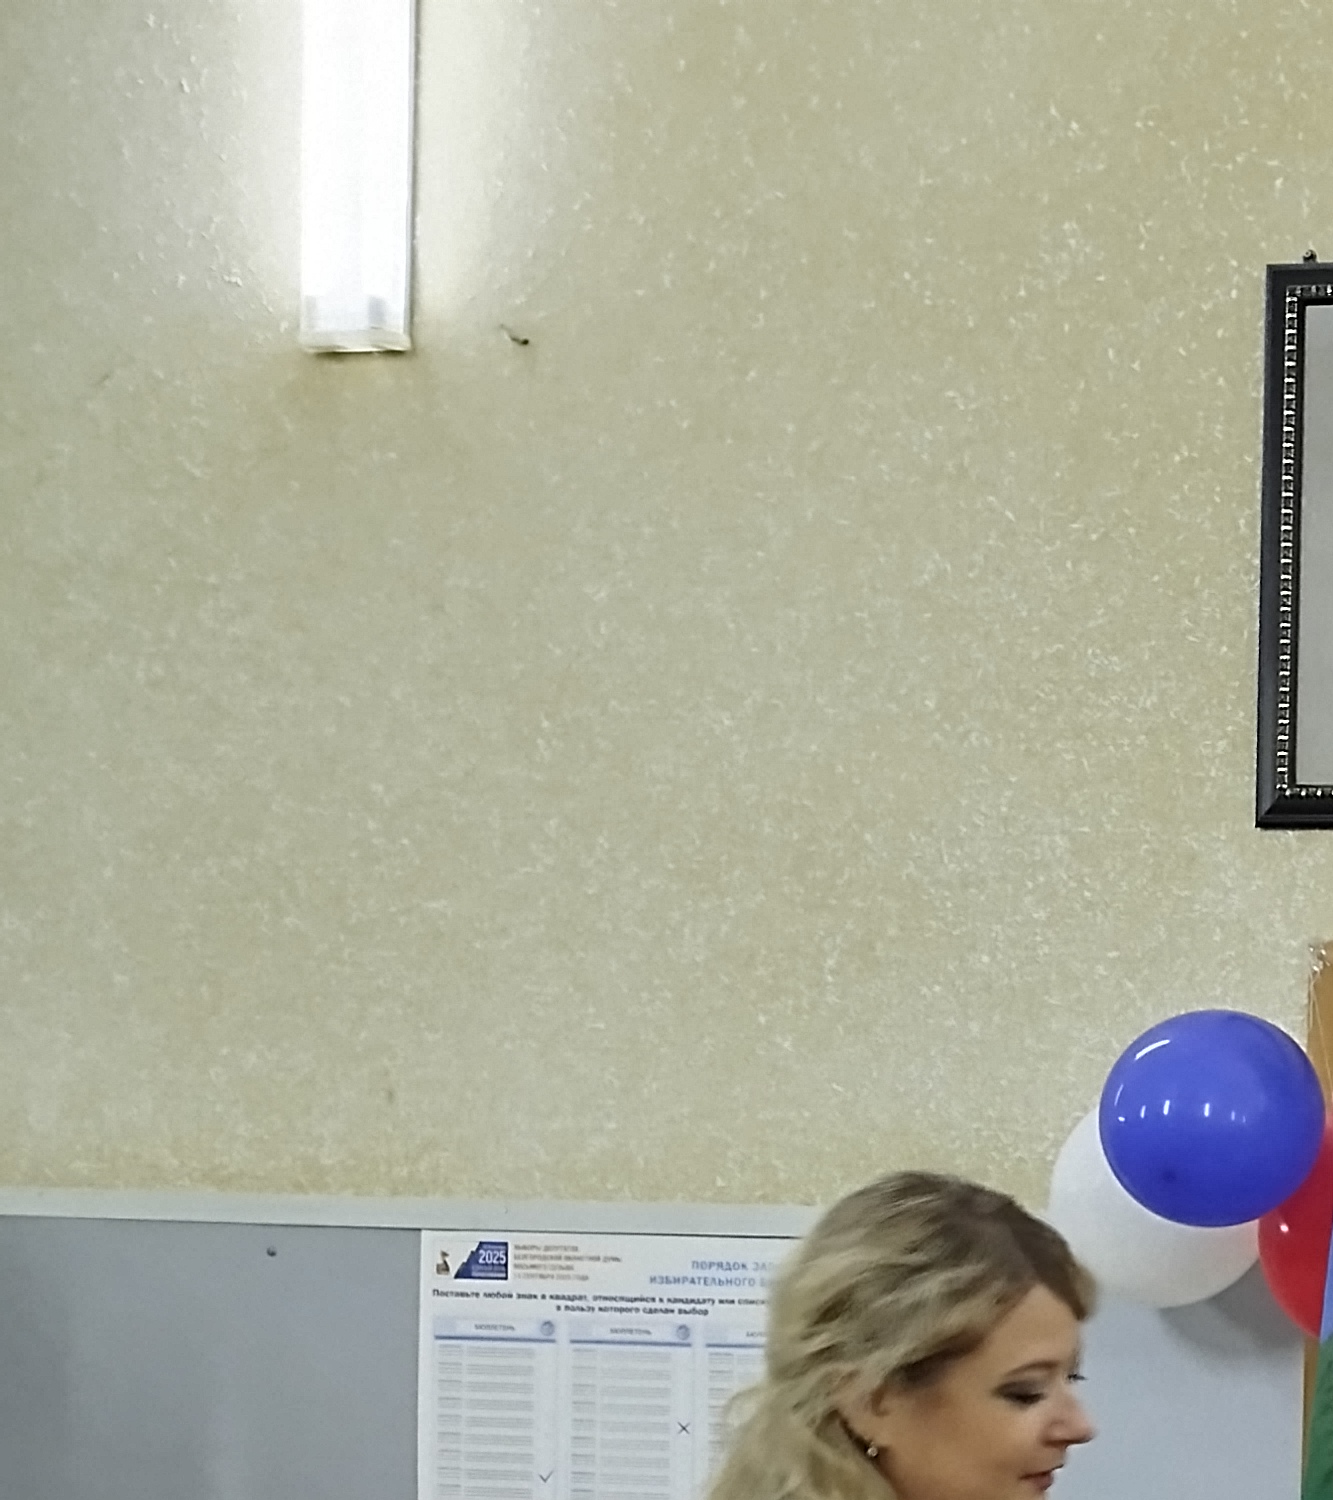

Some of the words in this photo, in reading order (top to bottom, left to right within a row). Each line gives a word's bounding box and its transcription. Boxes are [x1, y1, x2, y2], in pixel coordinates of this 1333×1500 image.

[478, 1250, 507, 1264] 2025
[692, 1260, 748, 1272] ПОРЯДОК
[649, 1275, 756, 1287] ИЗБИРАТЕЛЬНОГО
[432, 1289, 480, 1299] Поставьте
[678, 1306, 709, 1316] выбор
